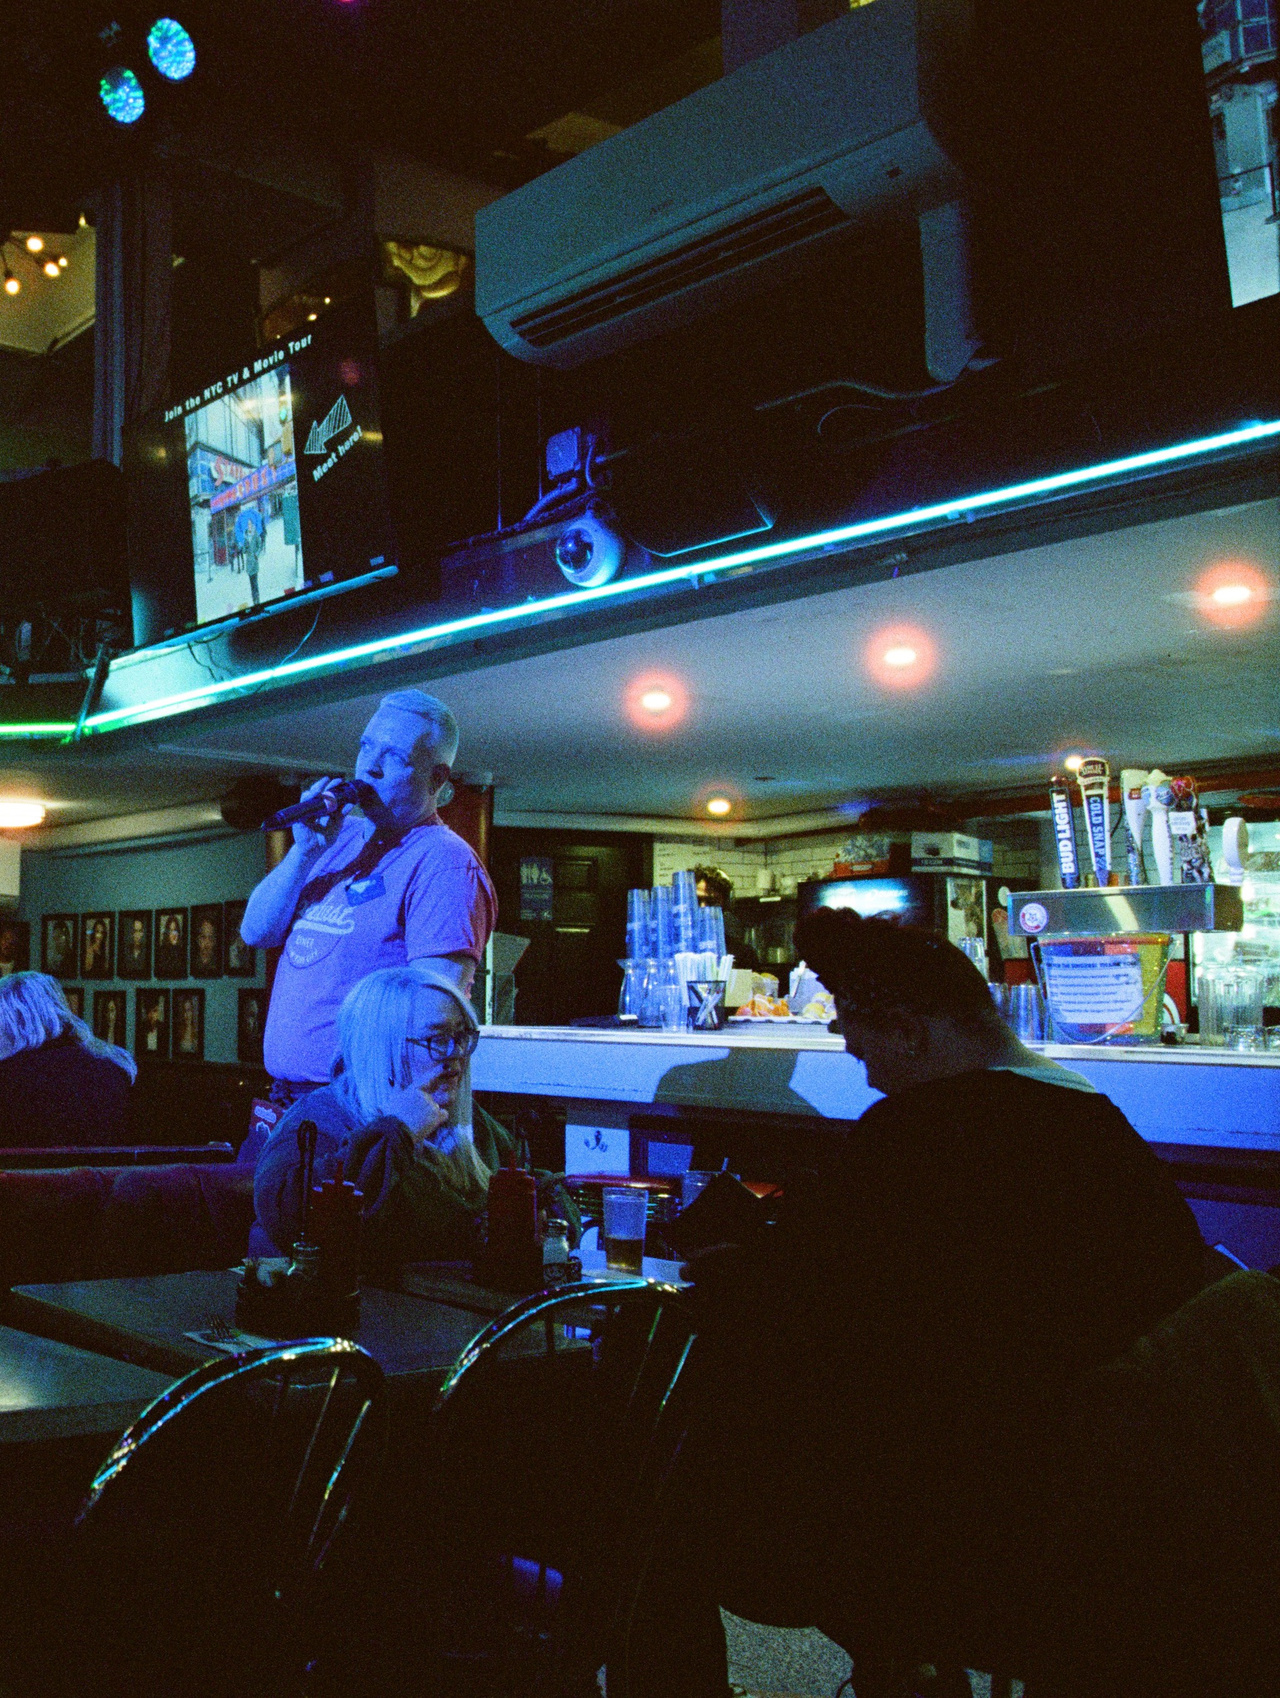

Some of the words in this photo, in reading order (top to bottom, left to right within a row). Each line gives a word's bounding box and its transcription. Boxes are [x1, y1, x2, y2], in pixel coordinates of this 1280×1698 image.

[164, 404, 183, 423] Join
[185, 395, 201, 411] the
[204, 381, 224, 401] NYC
[226, 371, 240, 388] TV
[243, 366, 251, 381] &
[253, 349, 285, 373] Movie
[288, 334, 313, 355] Tour
[312, 452, 339, 482] Meet
[1052, 792, 1072, 841] LIGHT
[1089, 796, 1104, 826] COLD
[1058, 839, 1076, 874] BUD
[1092, 826, 1107, 858] SNAP
